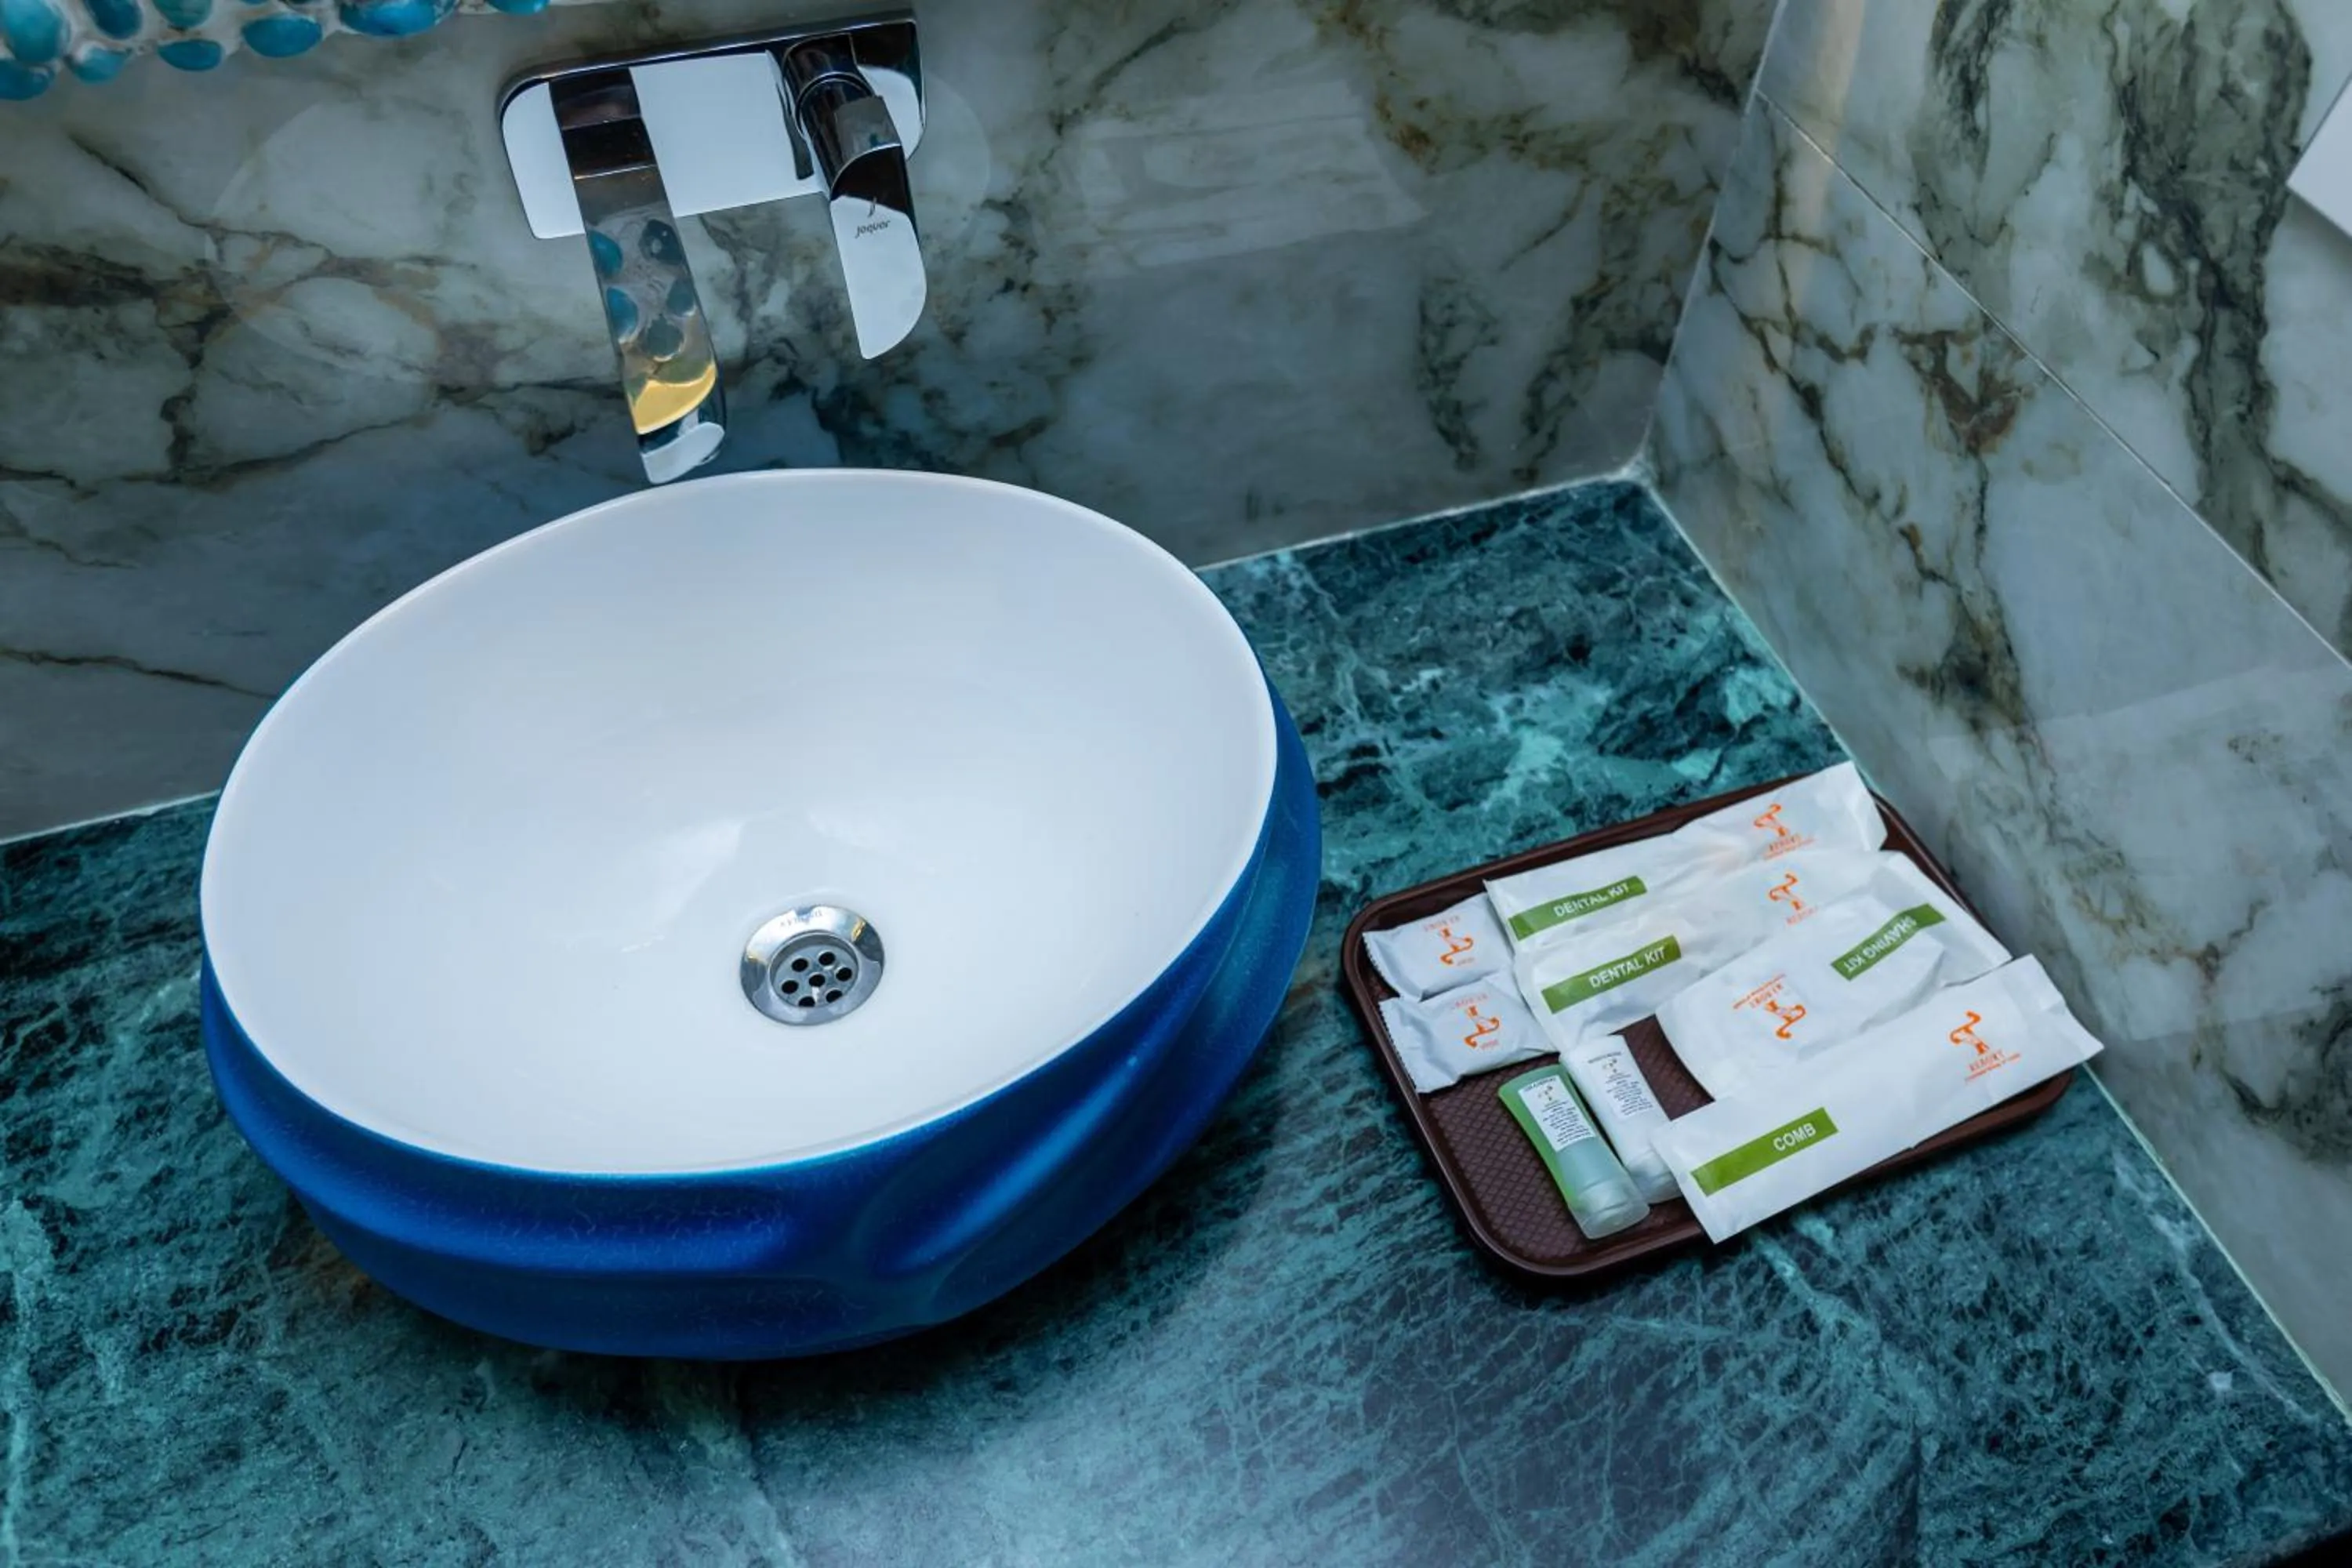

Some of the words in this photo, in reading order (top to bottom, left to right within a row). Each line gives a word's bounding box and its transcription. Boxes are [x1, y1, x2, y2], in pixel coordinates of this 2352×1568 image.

[1553, 893, 1607, 917] DENTAL
[1607, 882, 1630, 898] KIT
[1588, 958, 1643, 989] DENTAL
[1643, 946, 1666, 966] KIT
[1843, 954, 1867, 973] KIT
[1773, 1122, 1817, 1152] COMB
